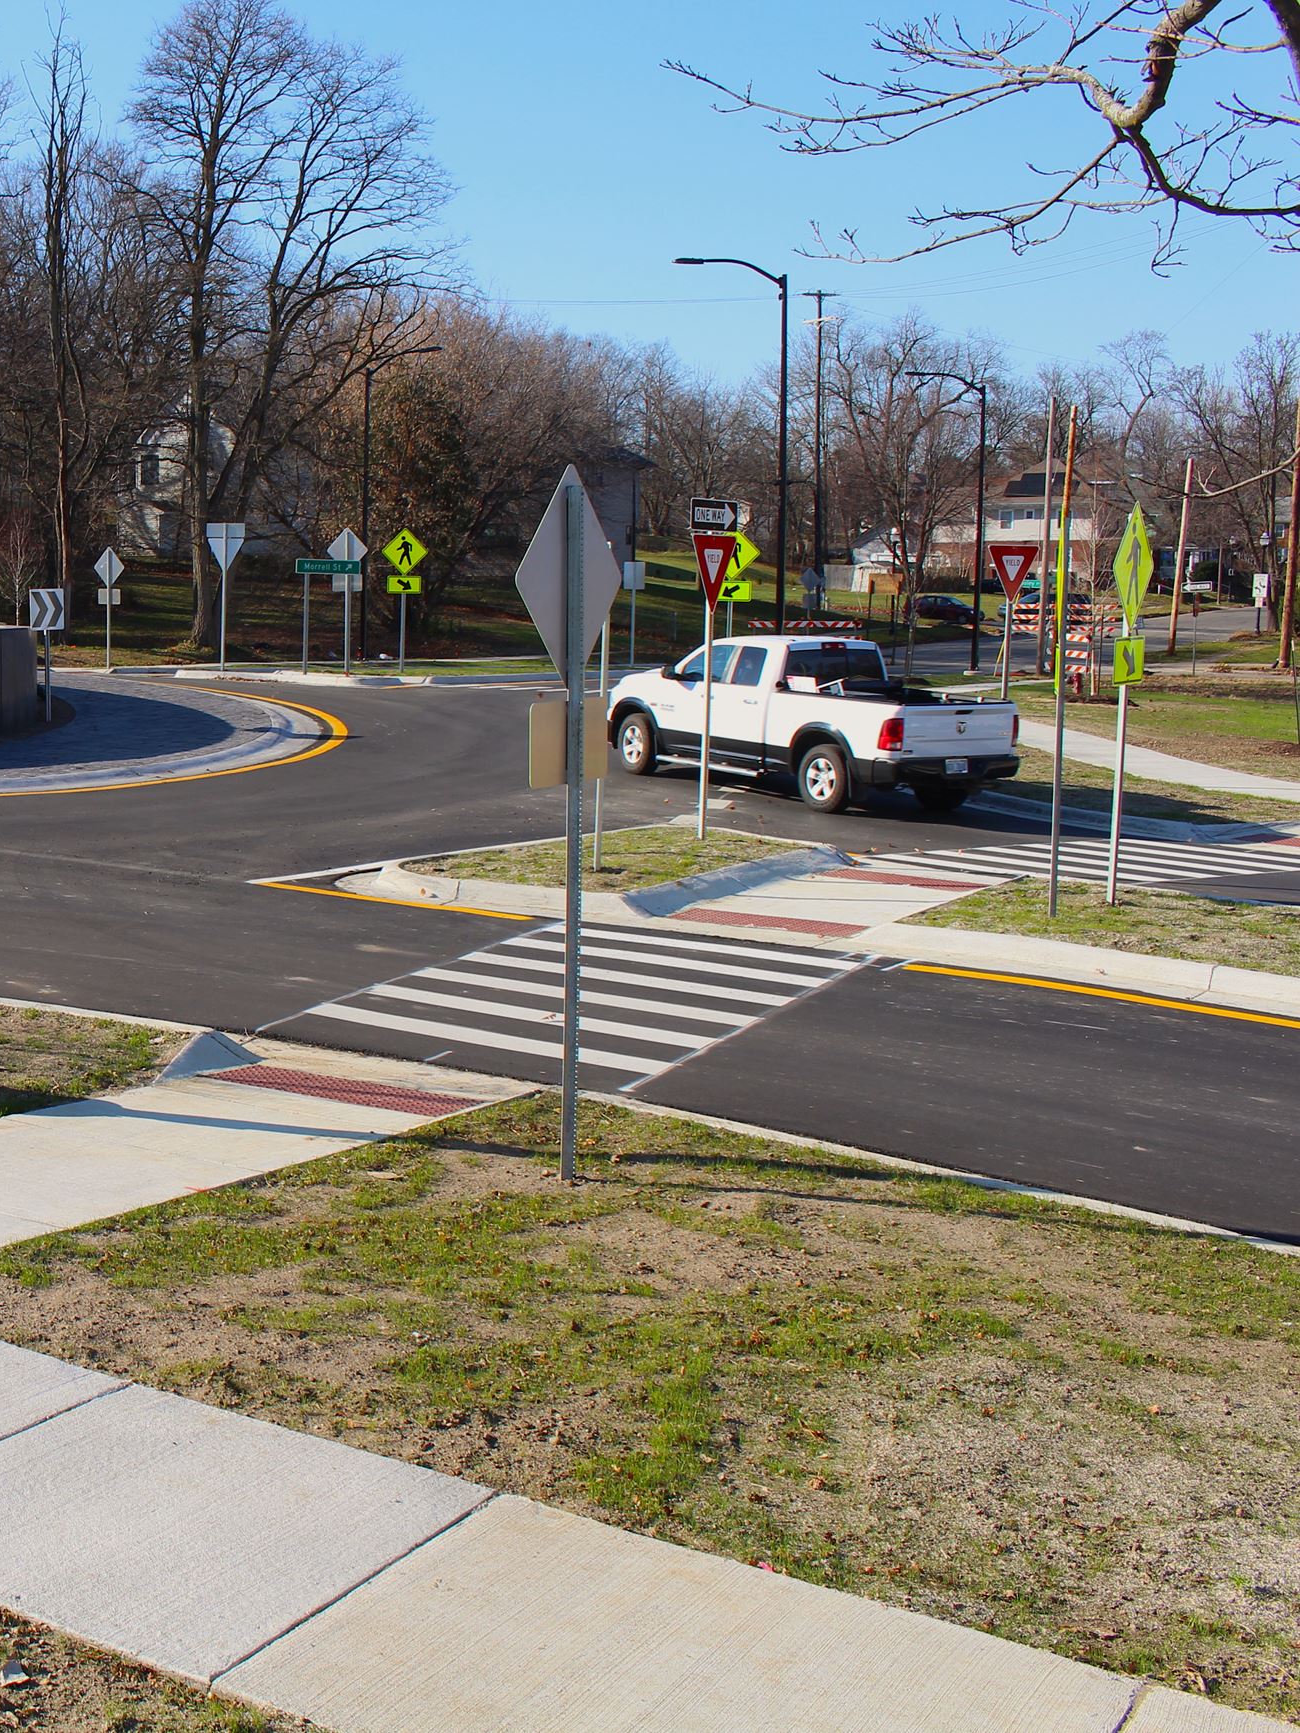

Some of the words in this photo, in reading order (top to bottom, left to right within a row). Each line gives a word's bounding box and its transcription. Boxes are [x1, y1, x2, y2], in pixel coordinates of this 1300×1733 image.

[696, 508, 710, 521] ONE
[711, 509, 725, 523] WAY
[708, 553, 720, 564] YIELD
[1006, 559, 1020, 567] YIELD
[304, 562, 330, 571] Morrell
[332, 563, 341, 571] St
